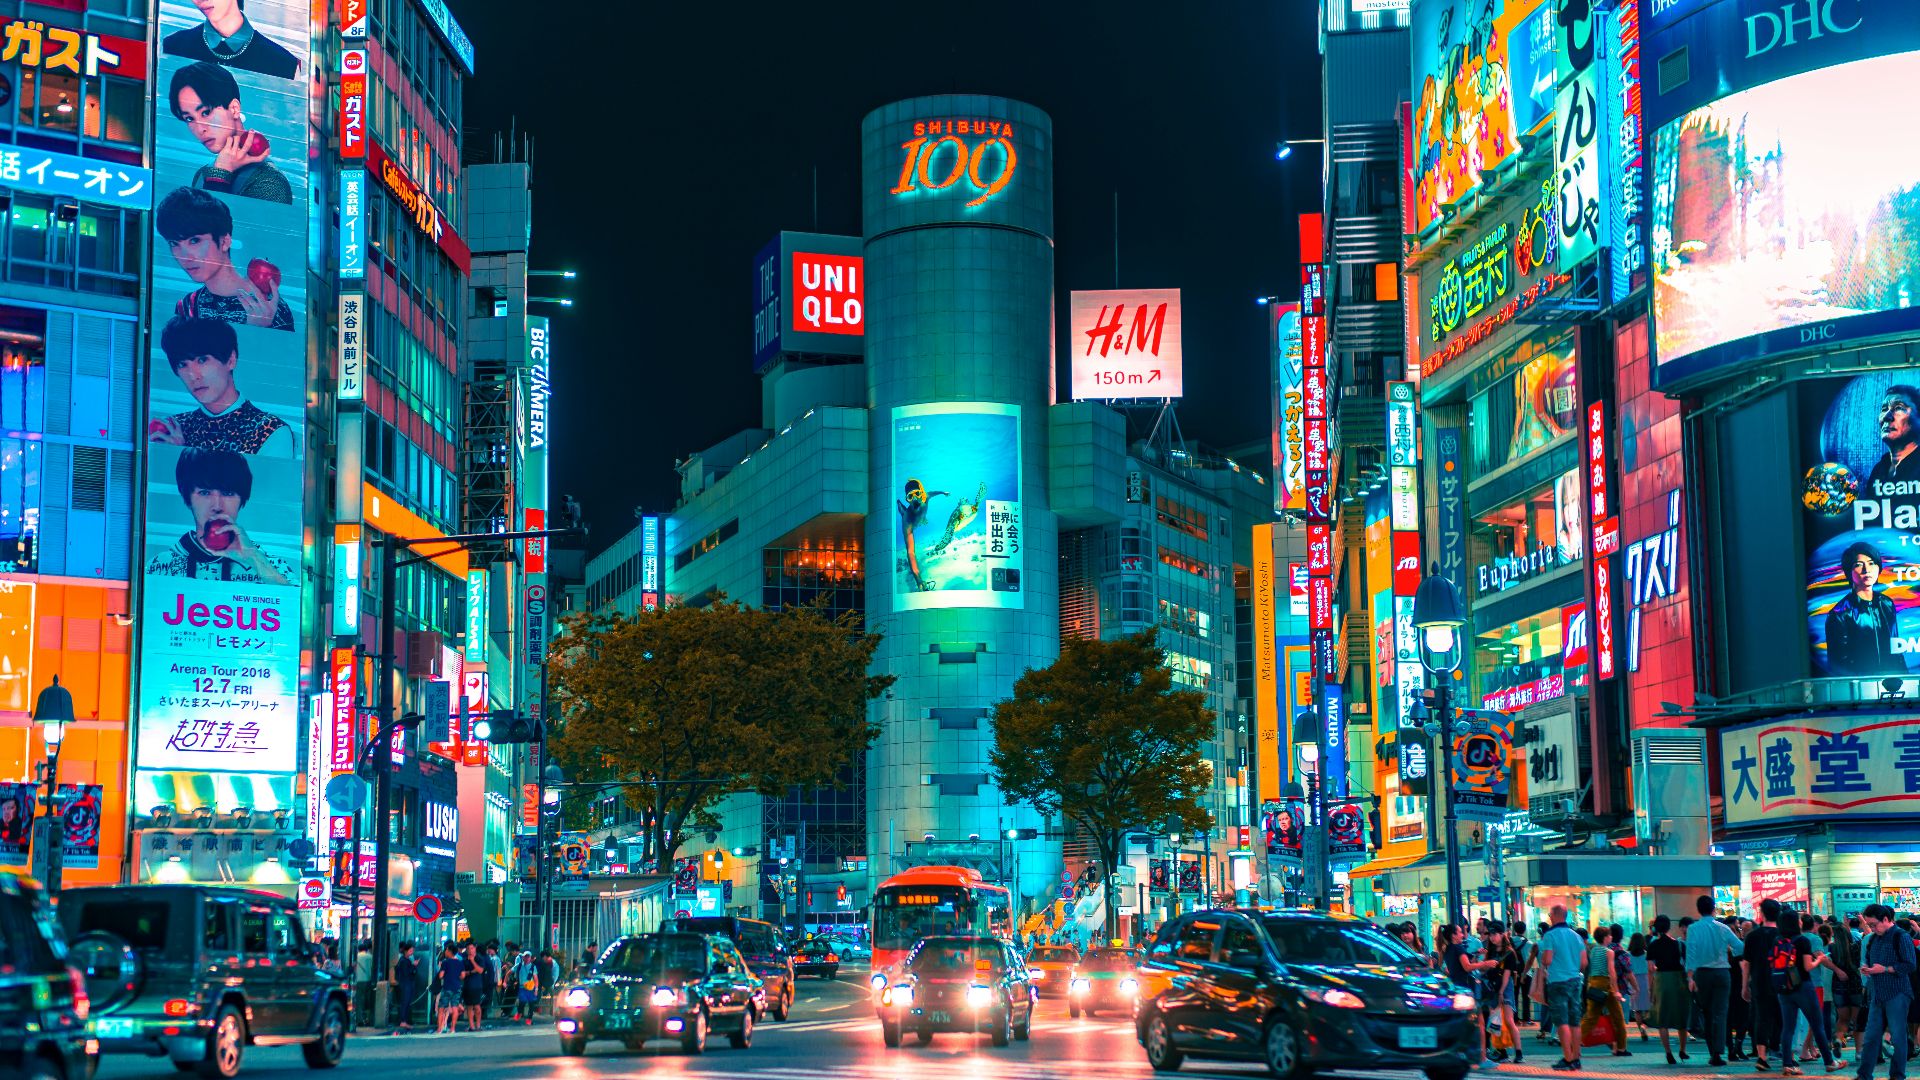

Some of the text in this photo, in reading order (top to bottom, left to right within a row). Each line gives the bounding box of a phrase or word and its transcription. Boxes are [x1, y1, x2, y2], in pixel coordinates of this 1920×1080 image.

[350, 27, 365, 36] 8F
[1744, 0, 1862, 59] DHC
[3, 20, 119, 78] ガスト
[345, 95, 363, 147] ガスト
[913, 120, 1014, 138] SHIBUYA
[890, 134, 1018, 209] 109
[345, 181, 359, 267] 英会話イーオン
[345, 269, 358, 278] 6F
[760, 254, 776, 296] THE
[802, 263, 858, 291] UNI
[1464, 244, 1508, 318] 西村
[754, 293, 781, 354] PRIME
[802, 296, 863, 327] QLO
[530, 327, 545, 359] BIC
[1084, 302, 1169, 358] H&M
[1800, 323, 1836, 343] DHC
[343, 302, 358, 391] 渋谷駅前ビル
[1093, 370, 1143, 385] 150m
[1309, 368, 1319, 376] 7F
[1310, 420, 1320, 428] 7F
[990, 511, 1019, 524] 世界に
[991, 524, 1019, 540] 出会
[1313, 526, 1323, 535] 6F
[990, 539, 1020, 554] おう
[1396, 556, 1419, 570] JTB
[1478, 541, 1554, 591] Euphoria
[1314, 579, 1325, 588] 6F
[162, 593, 281, 632] Jesus
[252, 596, 281, 605] SINGLE
[1259, 561, 1271, 681] Matsumoto KiYoshi
[1399, 614, 1409, 647] パーラー
[529, 615, 543, 666] 調剤薬局
[170, 663, 271, 679] Arena Tour 2018
[192, 677, 252, 695] 12.7 FRI
[159, 695, 280, 712] さいたまスーパーアリーナ
[435, 685, 447, 738] 渋谷駅前
[1401, 681, 1412, 713] フルーツ
[1327, 697, 1339, 748] MIZUHO
[468, 750, 478, 758] 3F
[1406, 743, 1427, 779] HUB
[1465, 795, 1494, 805] Tik Tok
[426, 802, 458, 843] LUSH
[1740, 840, 1769, 850] TAISEIDO
